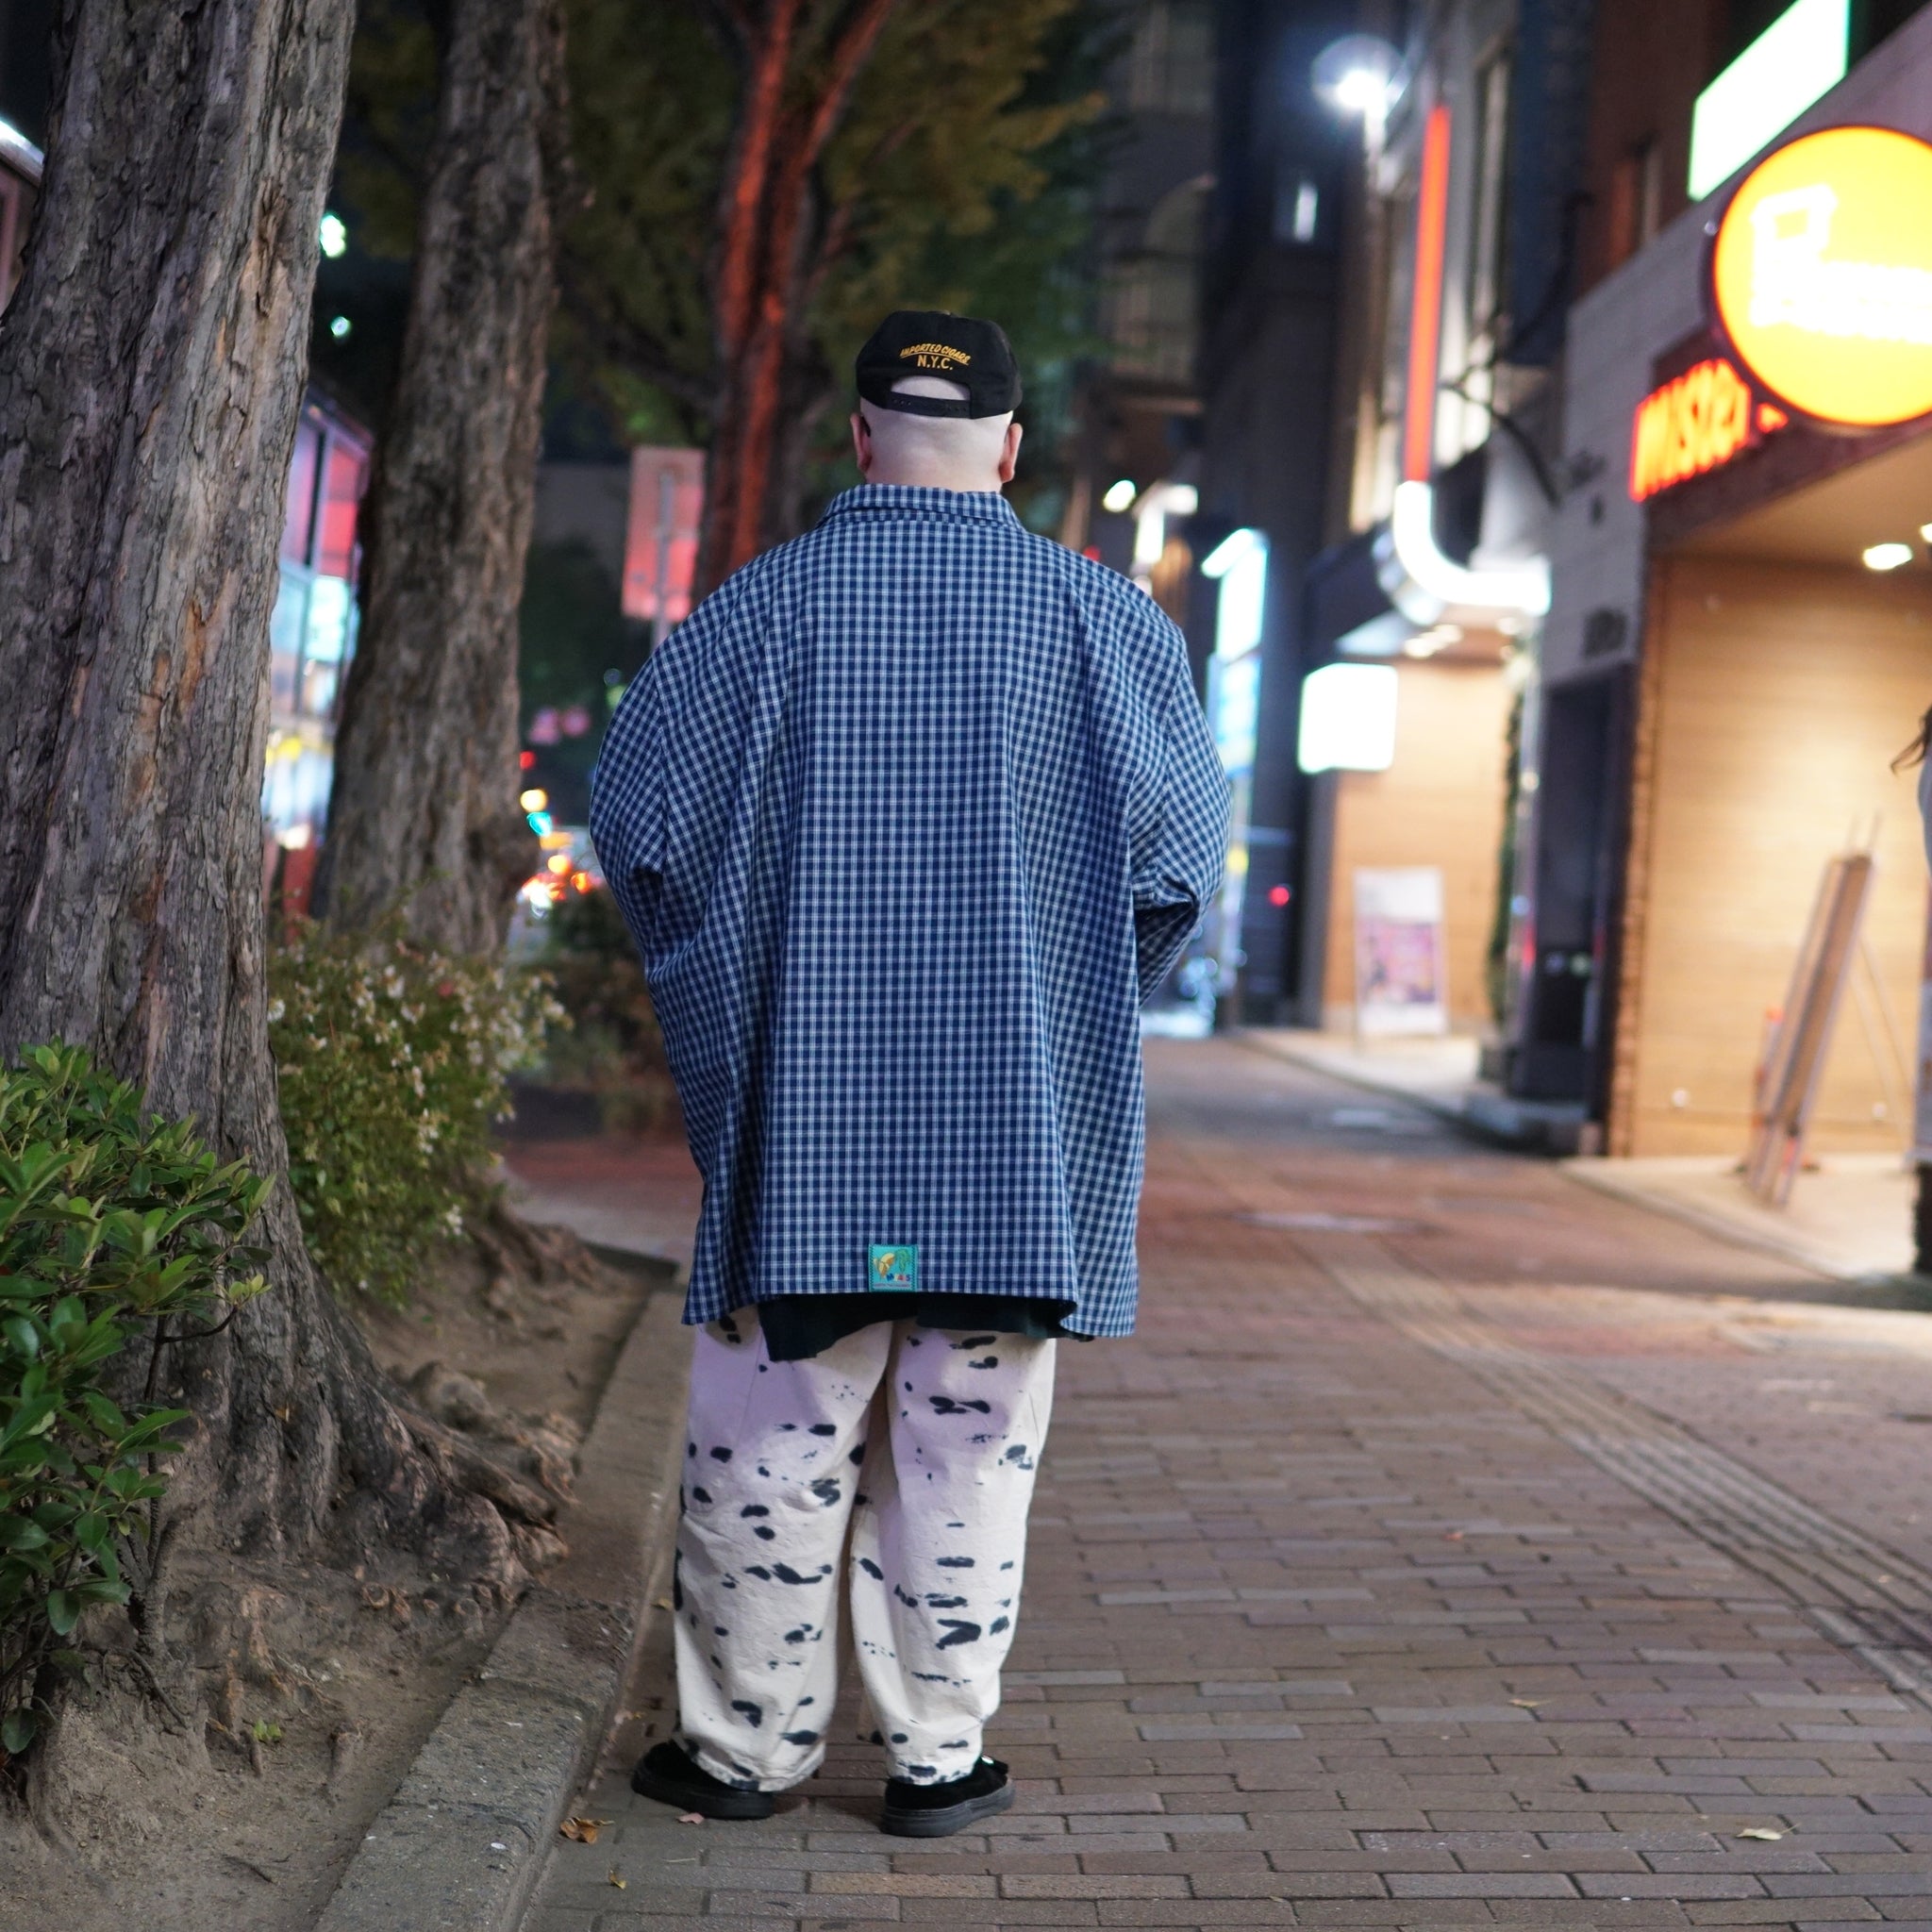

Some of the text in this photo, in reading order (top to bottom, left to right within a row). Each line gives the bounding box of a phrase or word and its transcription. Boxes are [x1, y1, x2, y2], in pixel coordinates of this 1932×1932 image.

[900, 343, 972, 363] IMPORTED CIGARS
[917, 355, 954, 370] N.Y.C.
